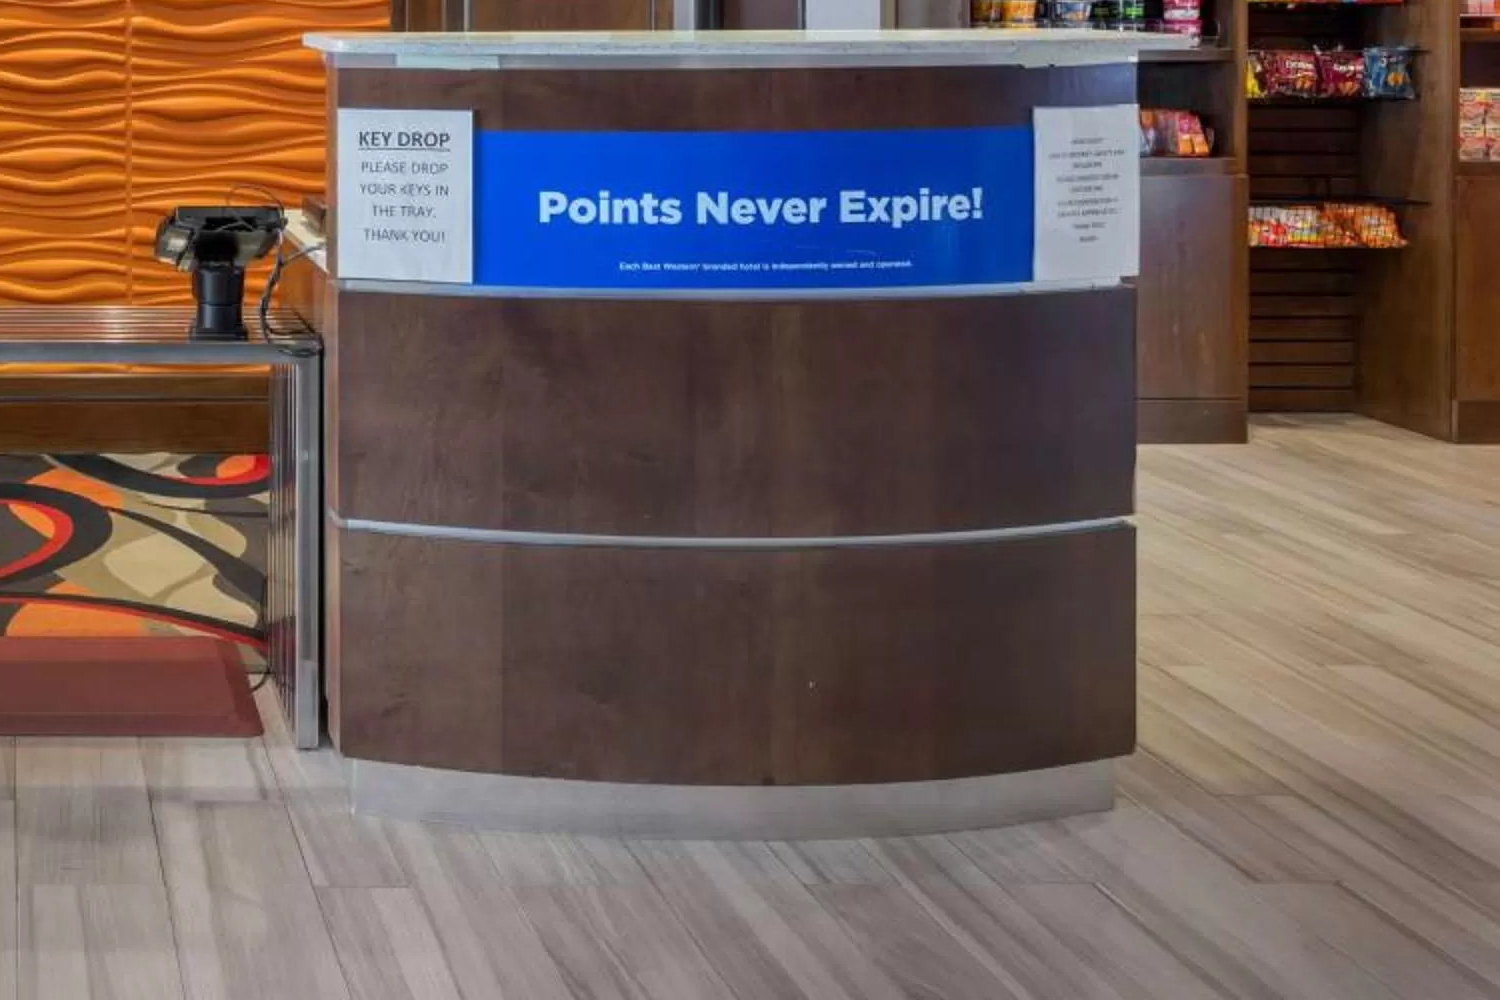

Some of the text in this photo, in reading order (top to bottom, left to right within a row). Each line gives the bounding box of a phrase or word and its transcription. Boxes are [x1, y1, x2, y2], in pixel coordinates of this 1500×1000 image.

[358, 131, 451, 148] KEY DROP
[360, 161, 449, 175] PLEASE DROP
[359, 183, 450, 197] YOUR KEYS IN
[371, 205, 438, 219] THE TRAY.
[538, 186, 984, 229] Points Never Expire!
[363, 228, 446, 244] THANK YOU!
[619, 262, 641, 272] Each
[739, 262, 761, 272] hotel
